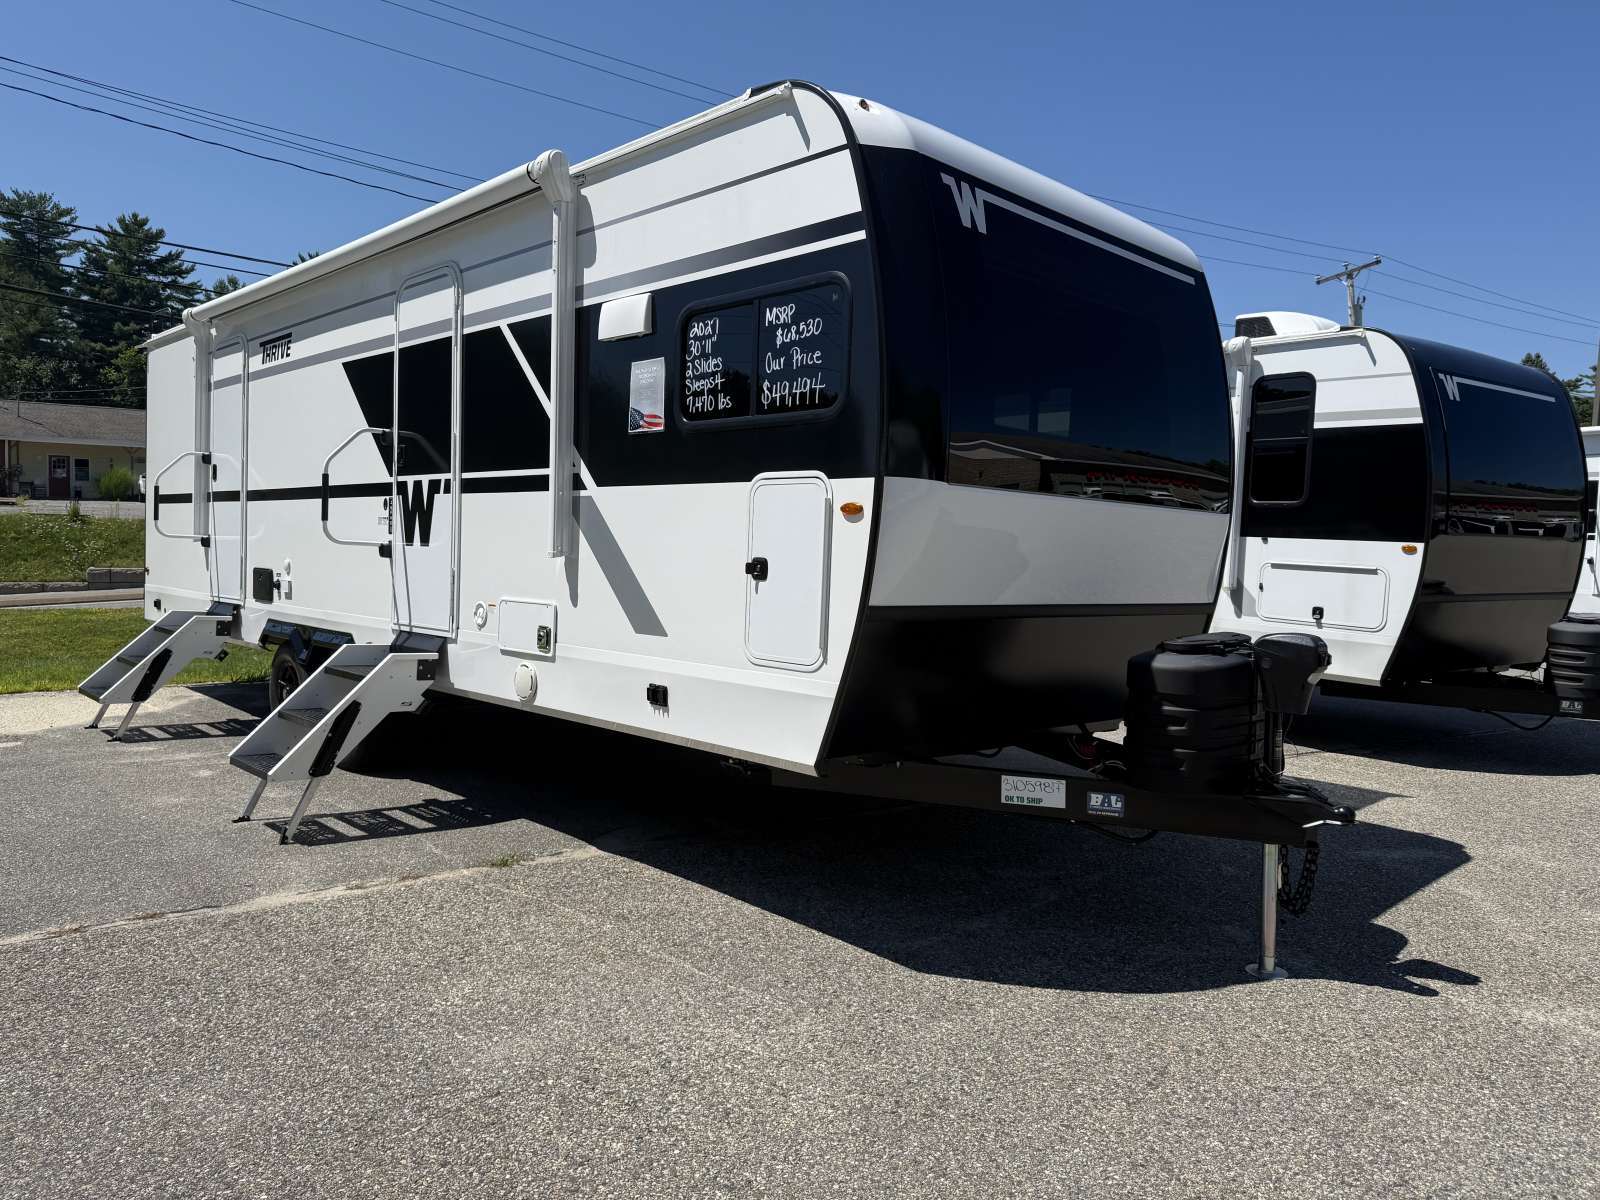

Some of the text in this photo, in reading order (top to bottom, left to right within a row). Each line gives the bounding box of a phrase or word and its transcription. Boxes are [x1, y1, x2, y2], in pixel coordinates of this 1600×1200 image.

[765, 303, 795, 327] MSRP
[690, 317, 719, 338] 2027
[776, 318, 823, 349] $68,530
[259, 332, 292, 365] THRIVE
[765, 346, 823, 374] Our Price
[686, 356, 723, 379] 2 Slides
[718, 393, 732, 411] lbs
[761, 372, 826, 410] $49,494
[1004, 795, 1044, 805] OK TO SHIP
